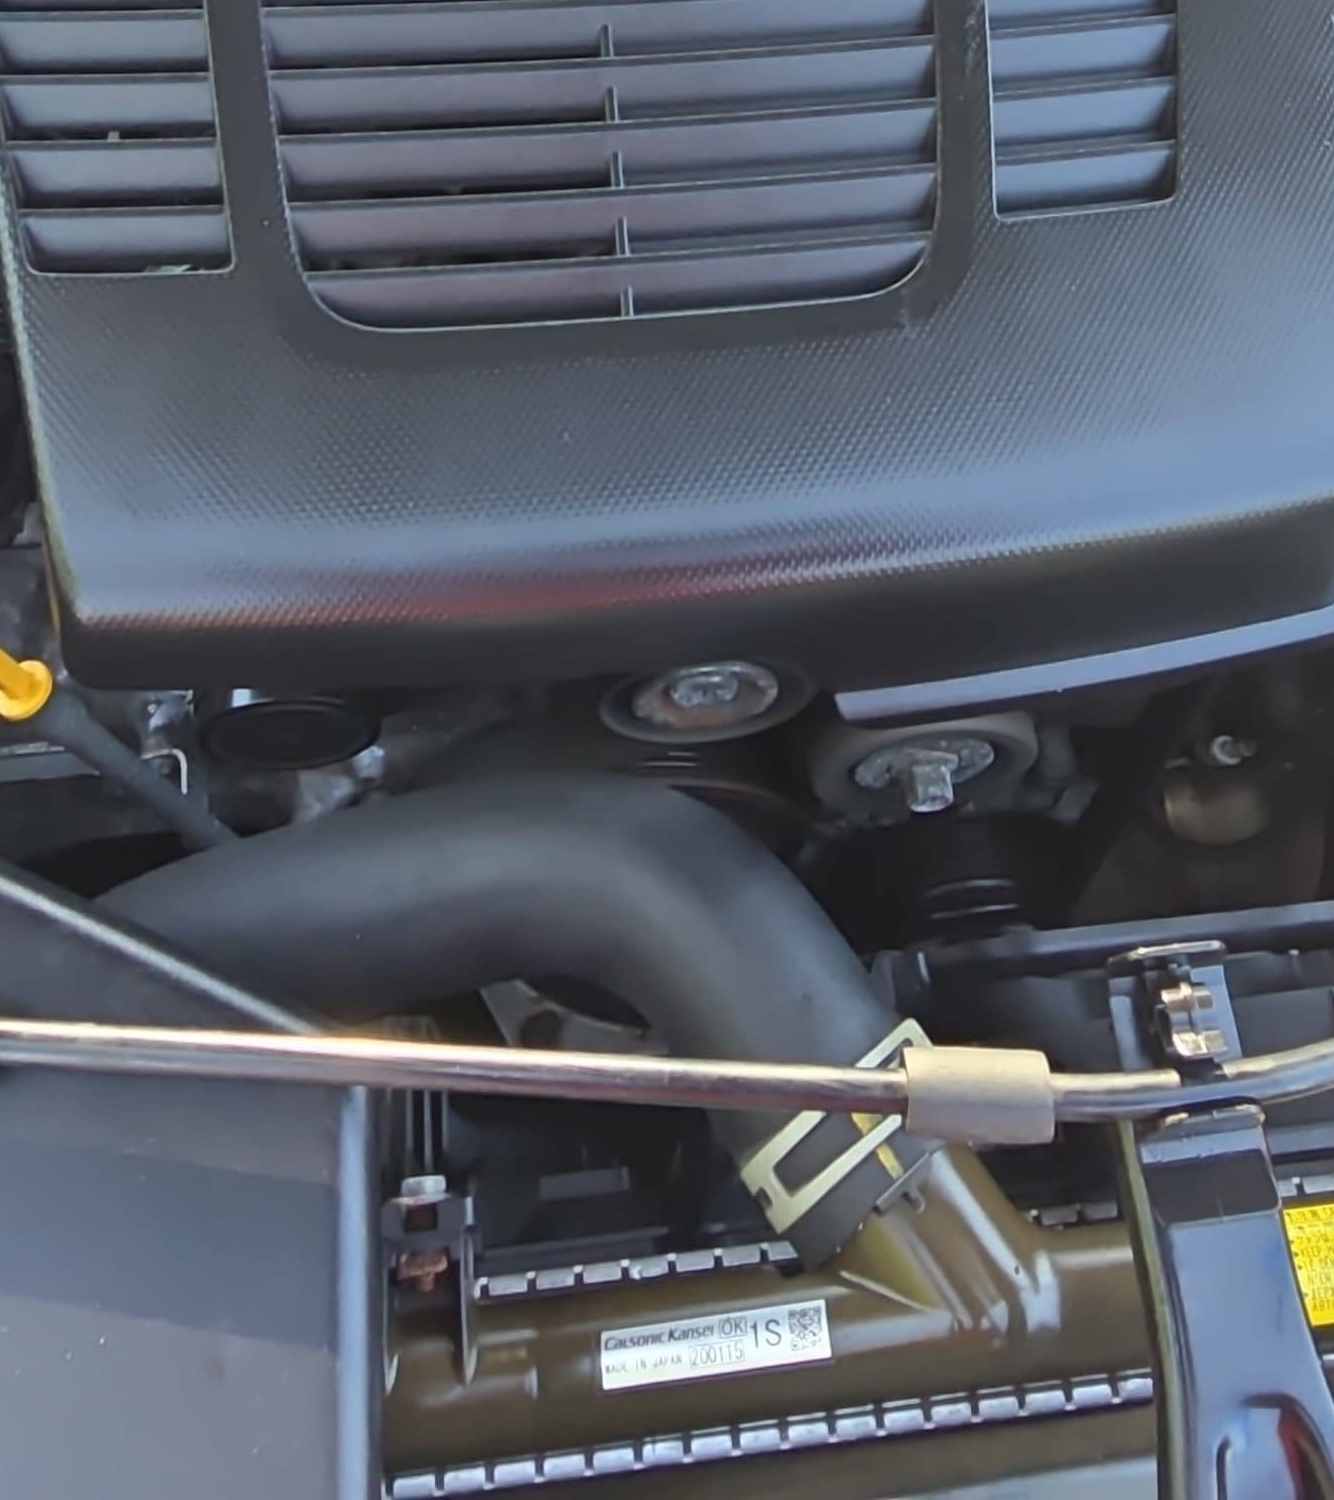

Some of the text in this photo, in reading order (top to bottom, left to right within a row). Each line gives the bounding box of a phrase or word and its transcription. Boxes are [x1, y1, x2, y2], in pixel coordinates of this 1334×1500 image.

[667, 1324, 715, 1343] Kansei
[721, 1317, 744, 1336] OK
[692, 1342, 744, 1366] 200115
